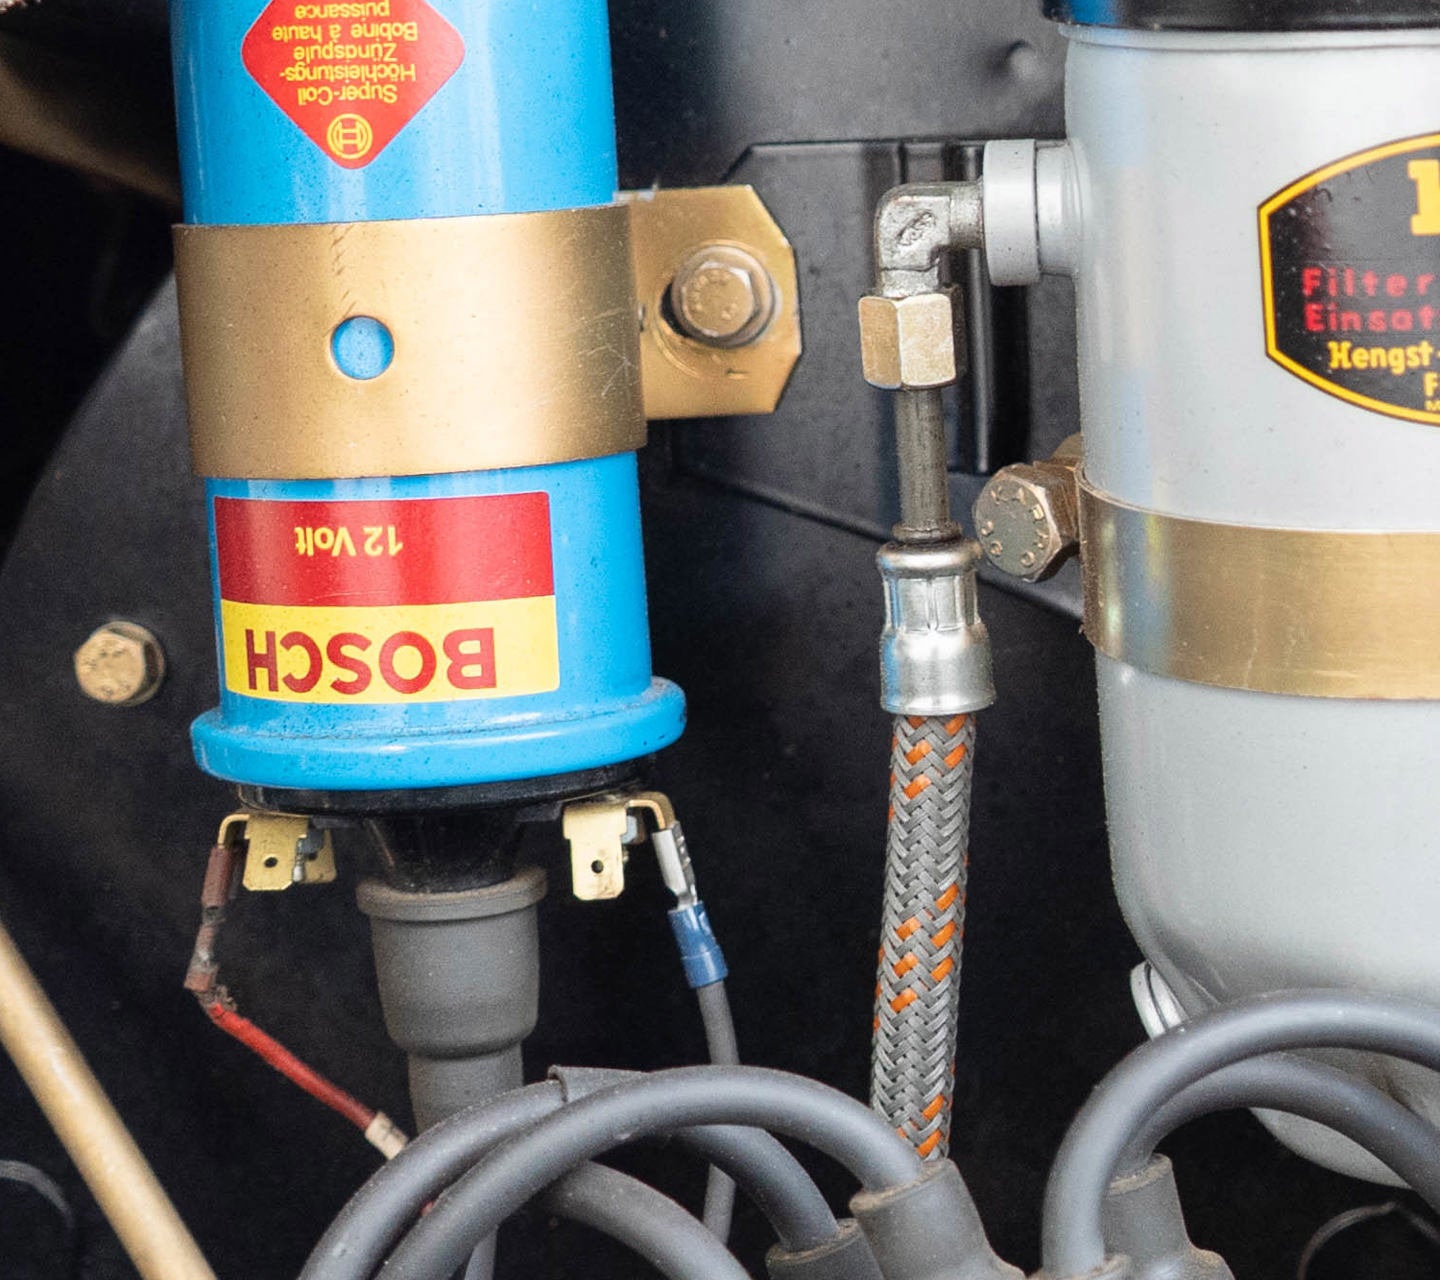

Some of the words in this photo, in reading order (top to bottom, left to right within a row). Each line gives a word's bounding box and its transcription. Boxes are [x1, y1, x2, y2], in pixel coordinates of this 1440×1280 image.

[272, 23, 322, 41] haute
[351, 21, 418, 41] Bobine
[293, 41, 397, 63] Zündspule
[298, 82, 398, 106] Super-Coil
[295, 527, 357, 557] Volt
[363, 527, 403, 556] 12
[245, 628, 497, 695] BOSCH
